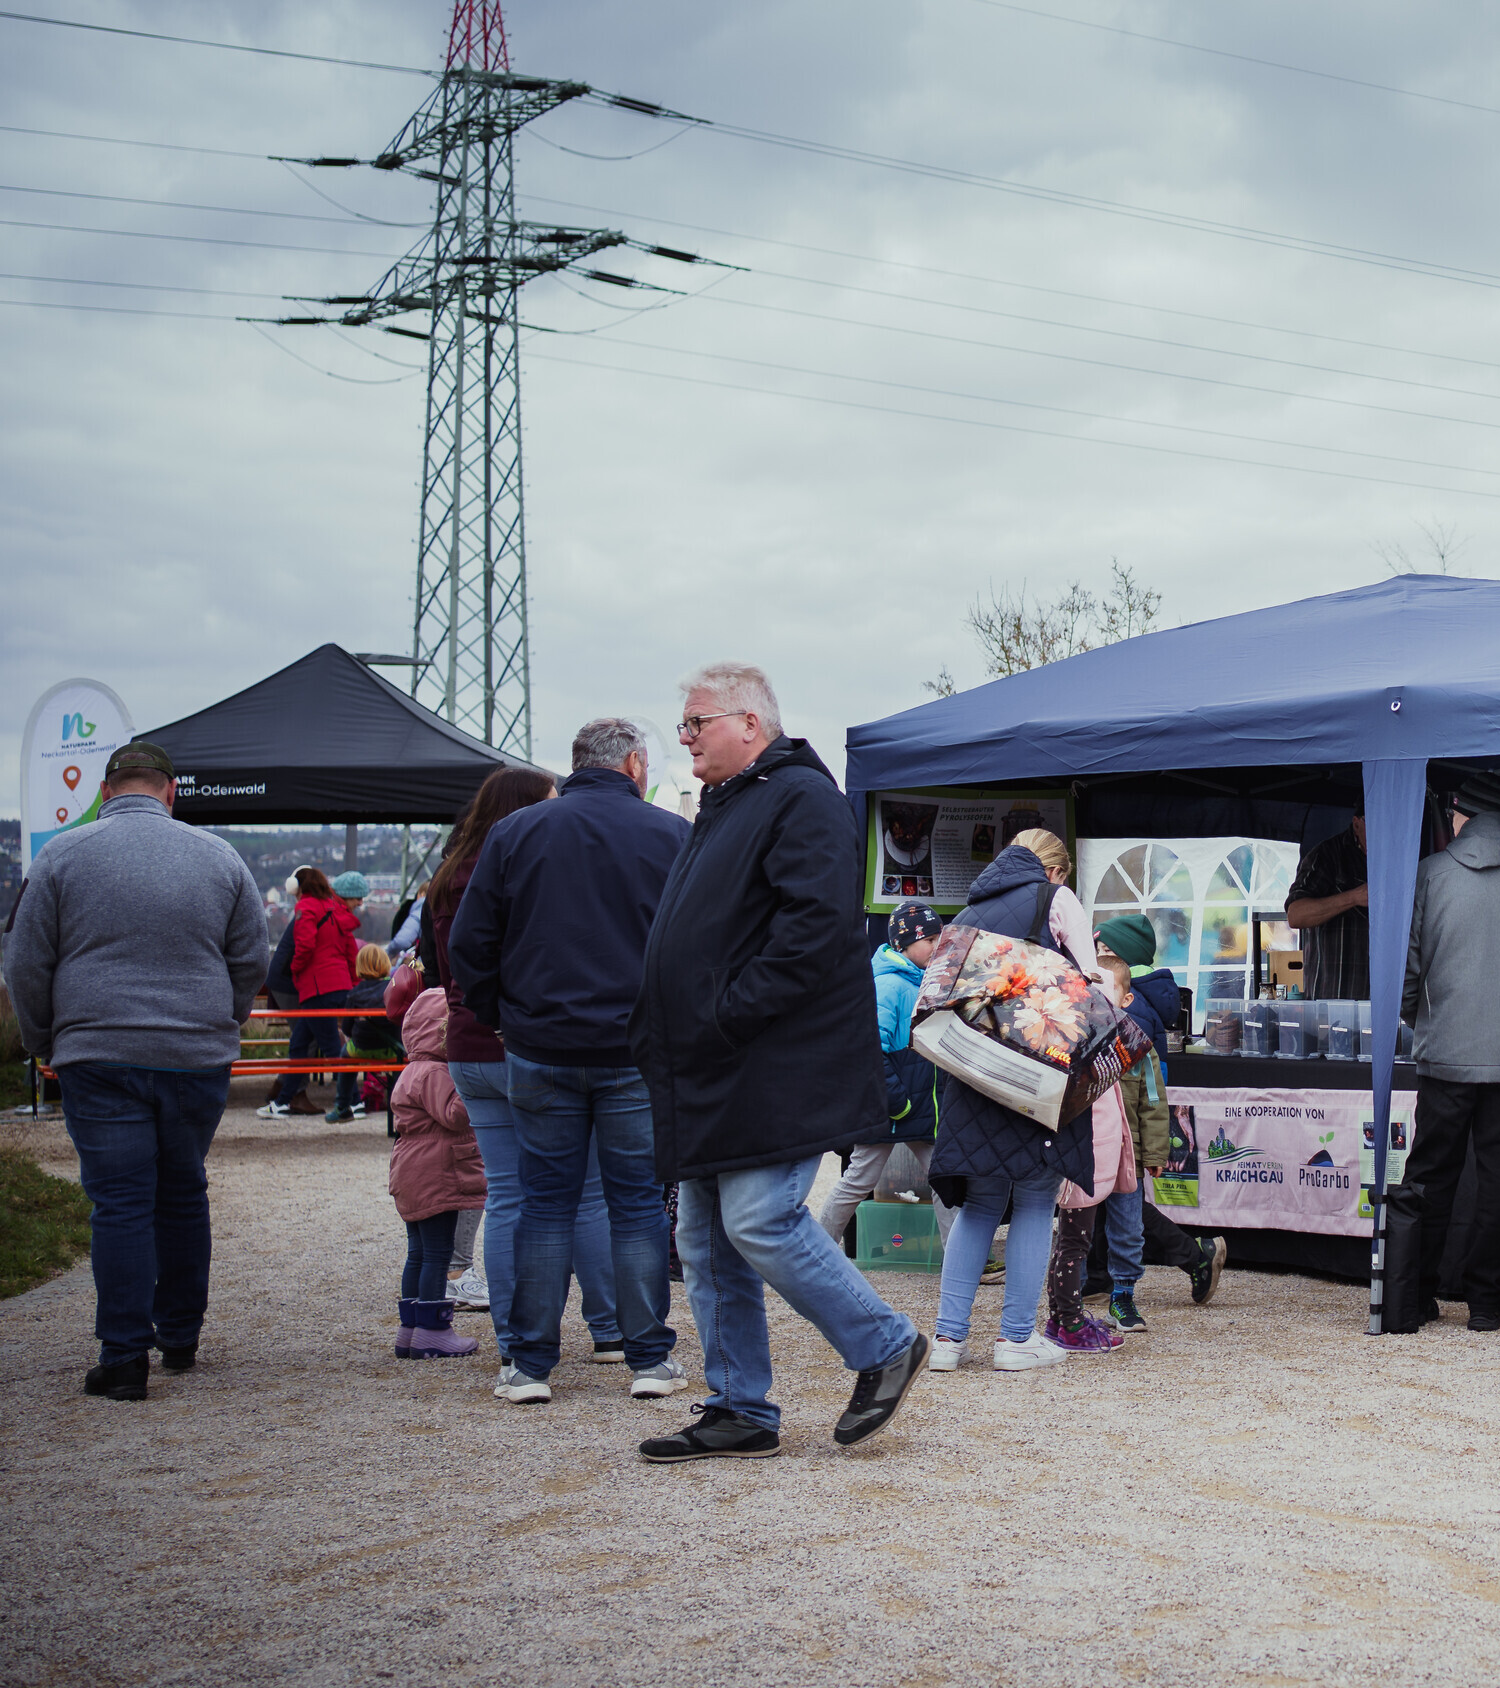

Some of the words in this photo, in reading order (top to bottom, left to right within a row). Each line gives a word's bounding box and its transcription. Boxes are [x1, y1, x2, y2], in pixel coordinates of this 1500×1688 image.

[41, 744, 117, 758] Neckartal-Odenwald
[176, 776, 196, 784] ARK
[176, 782, 266, 796] tal-Odenwald
[1225, 1107, 1242, 1117] EINE
[1244, 1106, 1302, 1118] KOOPERATION
[1306, 1108, 1324, 1120] VON
[1238, 1162, 1283, 1170] HEIMATVEREIN
[1216, 1170, 1283, 1184] KRAICHGAU
[1299, 1168, 1349, 1188] ProCarbo
